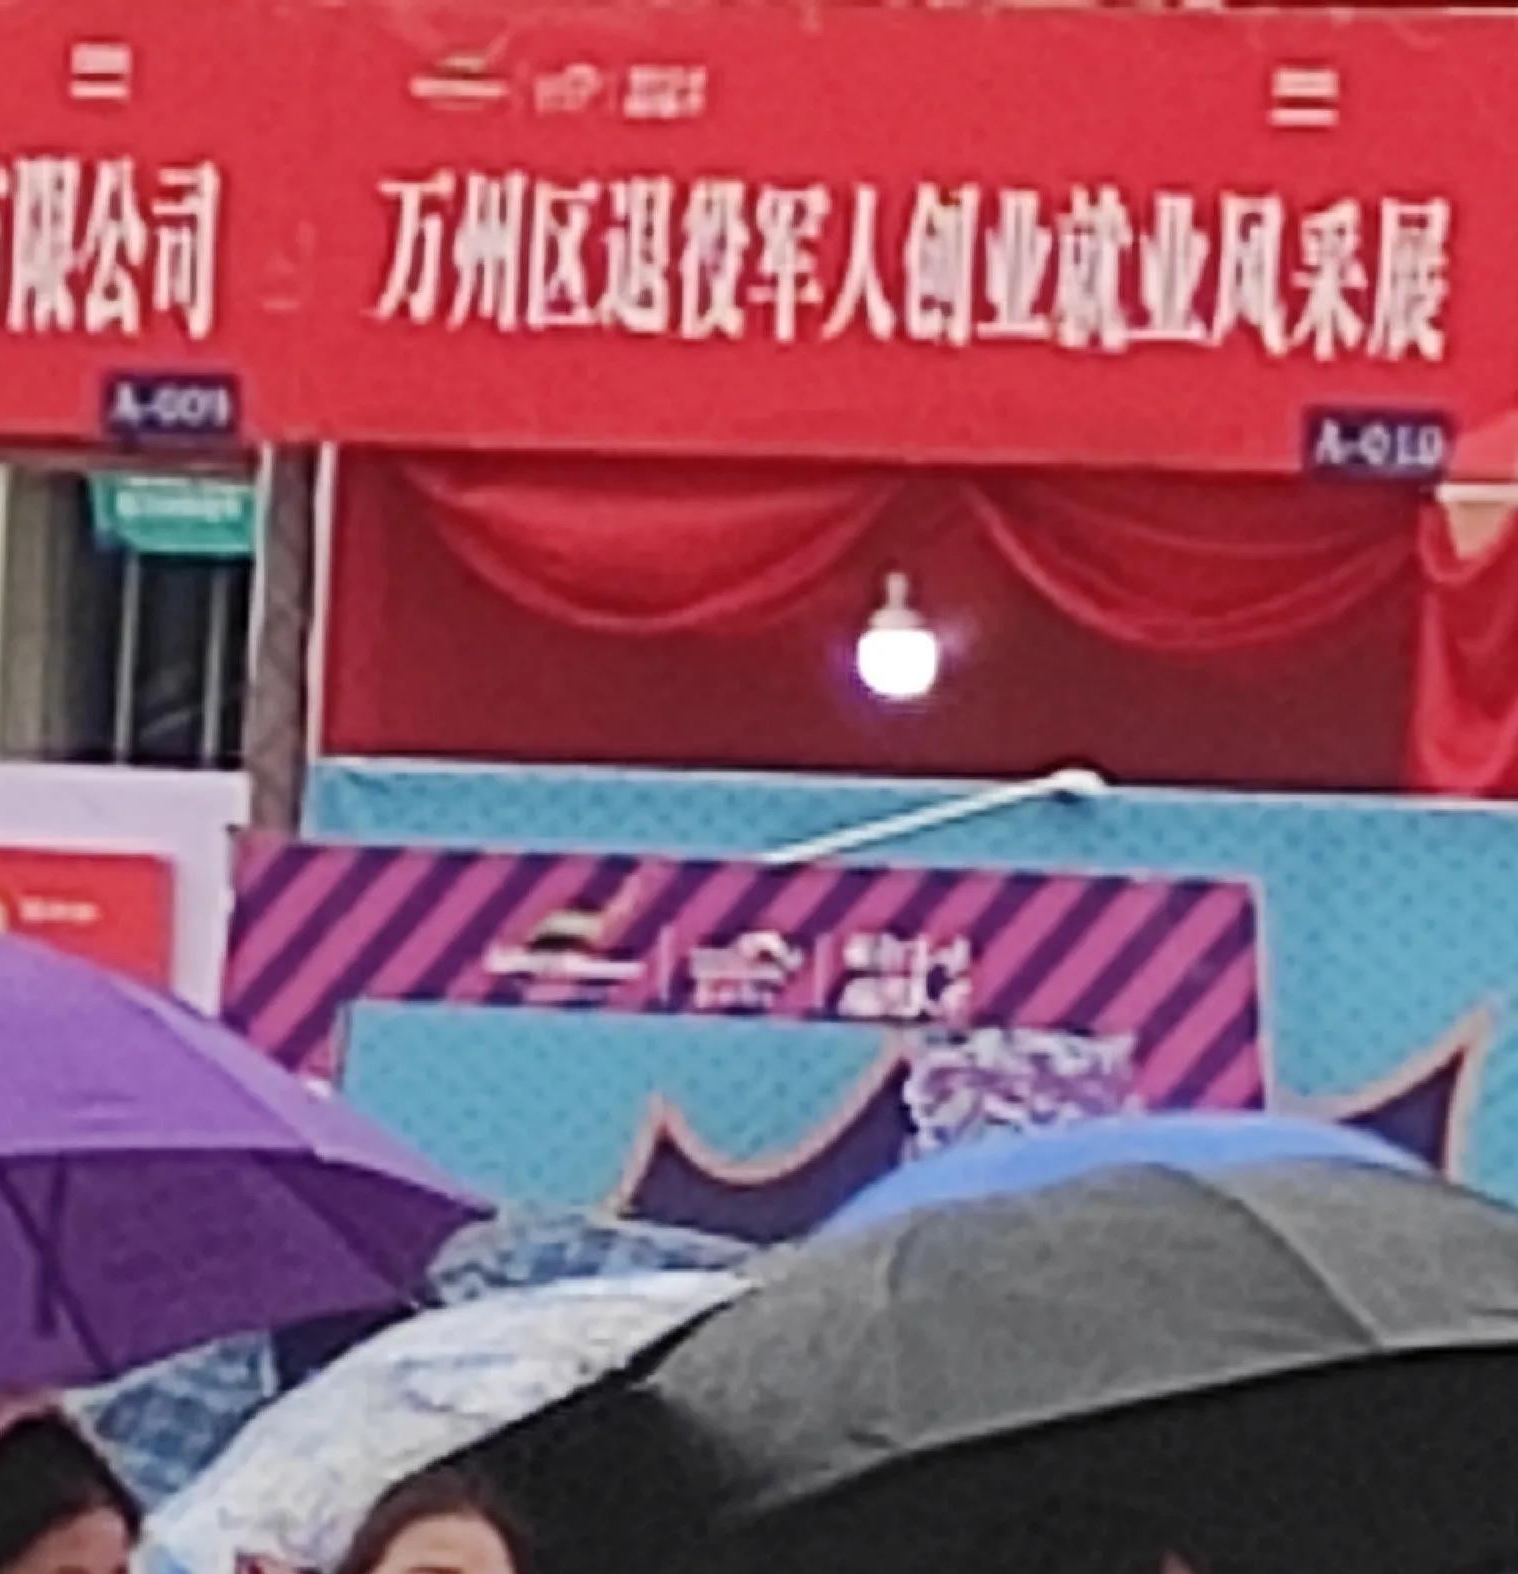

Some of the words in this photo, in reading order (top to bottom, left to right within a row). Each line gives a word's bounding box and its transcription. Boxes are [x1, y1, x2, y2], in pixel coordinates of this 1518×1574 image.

[367, 169, 1453, 362] 万州区退役军人创业就业风采展
[1316, 418, 1444, 467] A-010
